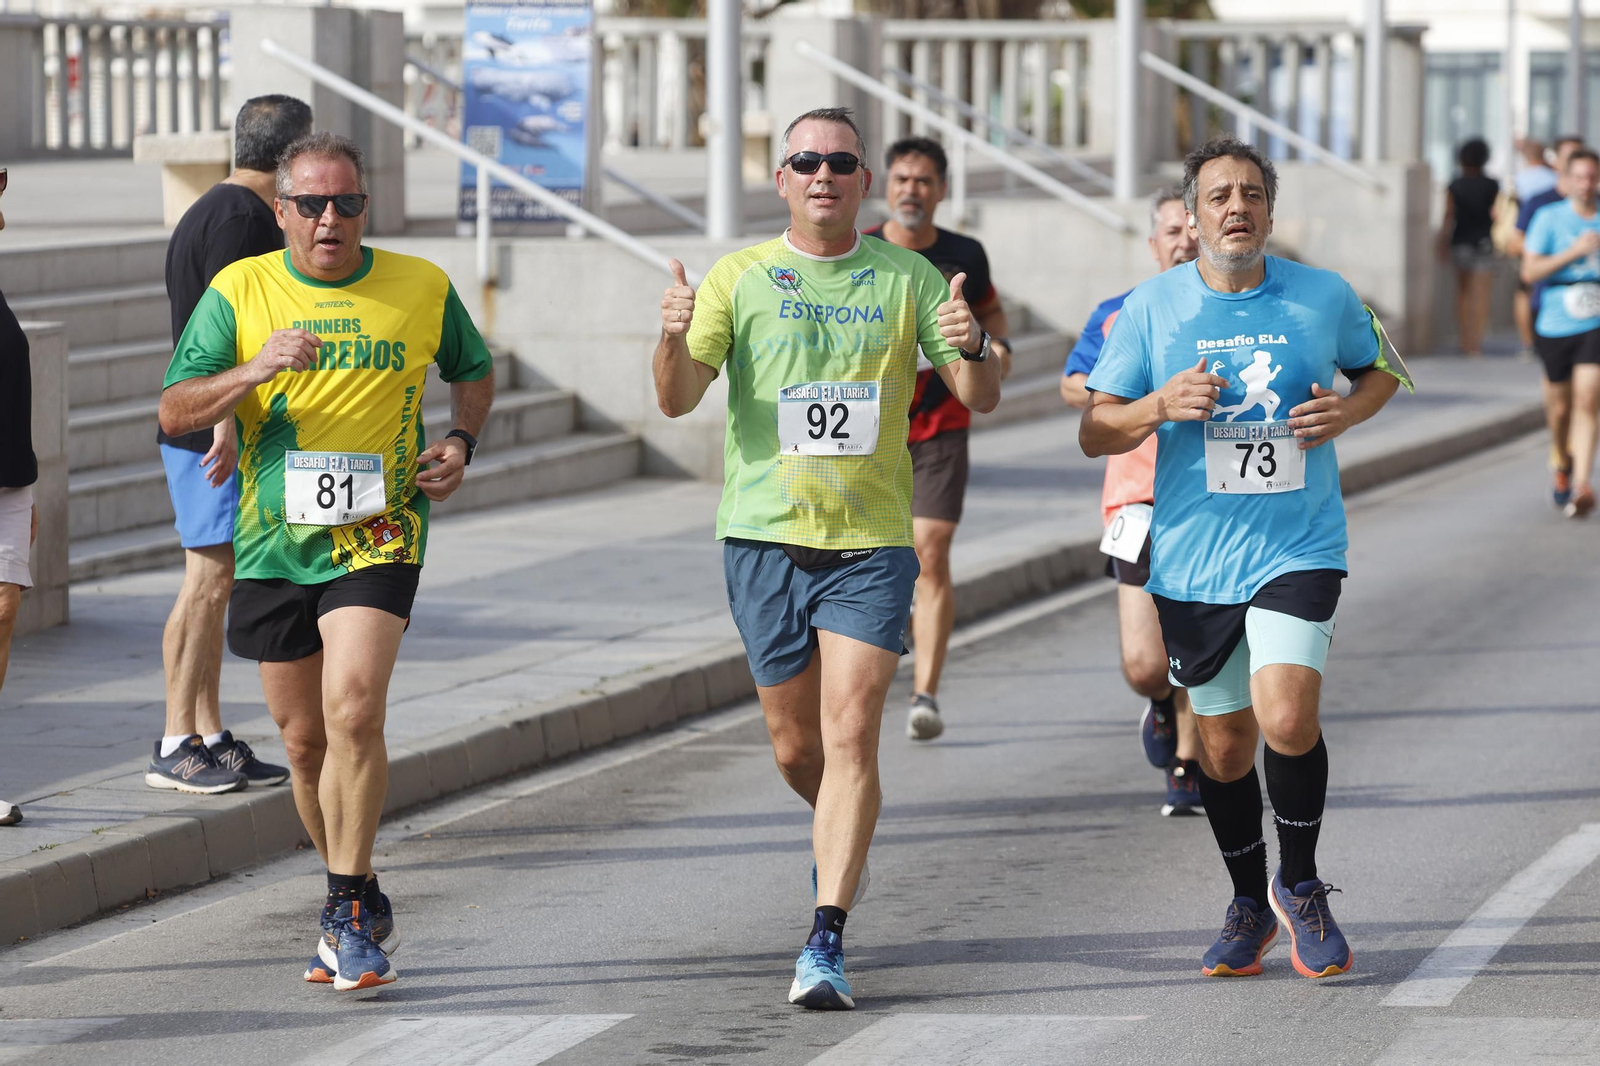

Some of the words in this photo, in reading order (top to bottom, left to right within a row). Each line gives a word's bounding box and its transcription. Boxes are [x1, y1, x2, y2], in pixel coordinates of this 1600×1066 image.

[779, 300, 884, 325] ESTEPONA
[292, 318, 362, 334] RUNNERS
[1196, 334, 1255, 350] Desafío
[1258, 334, 1288, 344] ELA
[821, 385, 841, 402] ELA
[842, 387, 869, 399] TARIFA
[806, 403, 850, 440] 92
[1249, 425, 1268, 441] ELA
[328, 456, 349, 472] ELA
[350, 459, 374, 470] TARIFA
[1235, 442, 1277, 478] 73
[316, 473, 354, 509] 81
